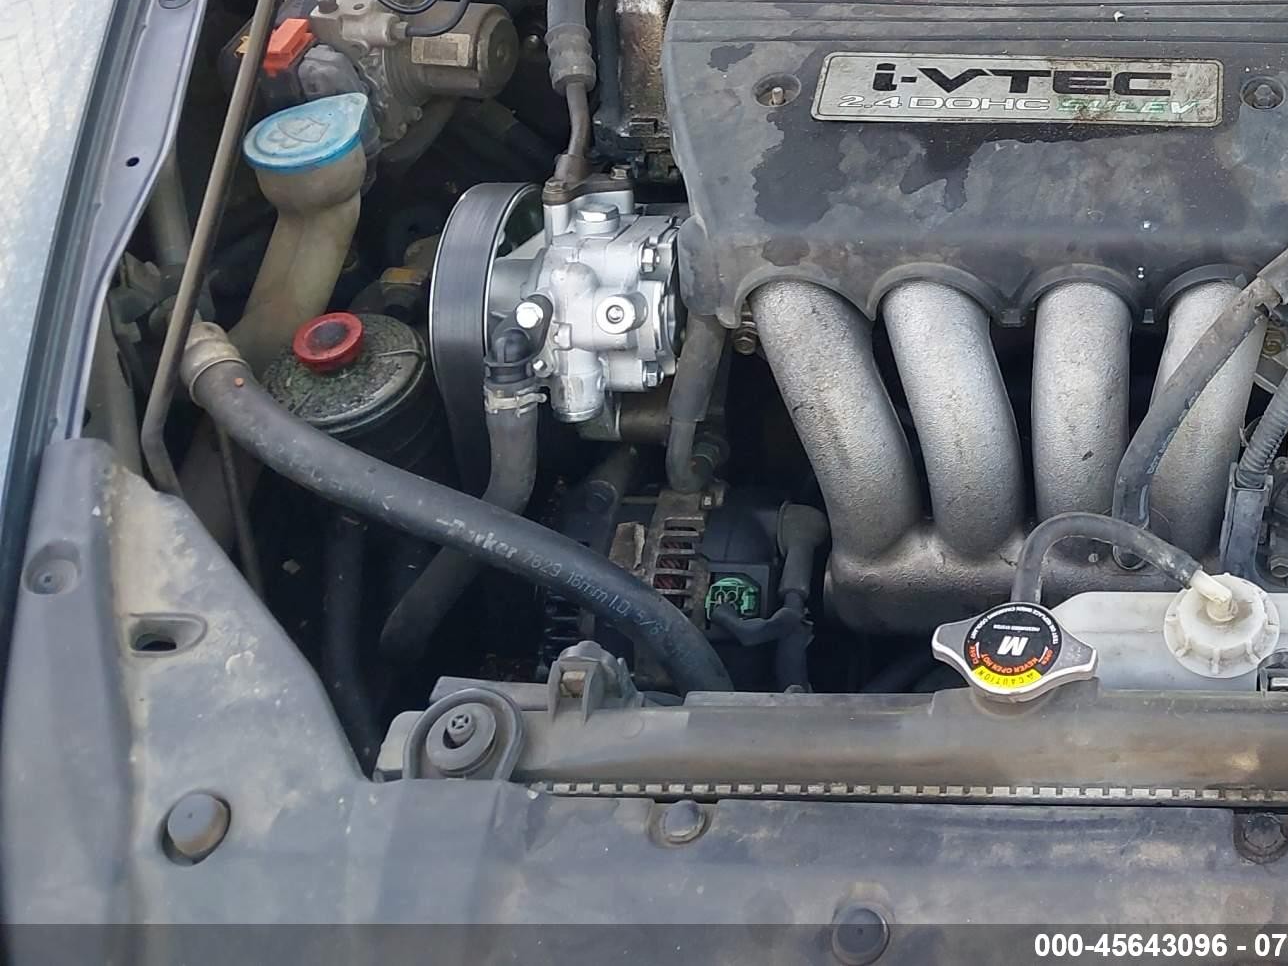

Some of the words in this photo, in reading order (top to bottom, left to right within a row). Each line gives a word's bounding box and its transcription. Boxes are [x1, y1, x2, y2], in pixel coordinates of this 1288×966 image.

[872, 62, 1171, 96] i-VTEC
[838, 95, 902, 109] 2.4
[907, 96, 1049, 111] DOHC
[1055, 99, 1201, 115] SULEV
[981, 653, 993, 668] HOT
[993, 663, 1013, 674] OPEN
[977, 670, 1024, 687] CAUTION
